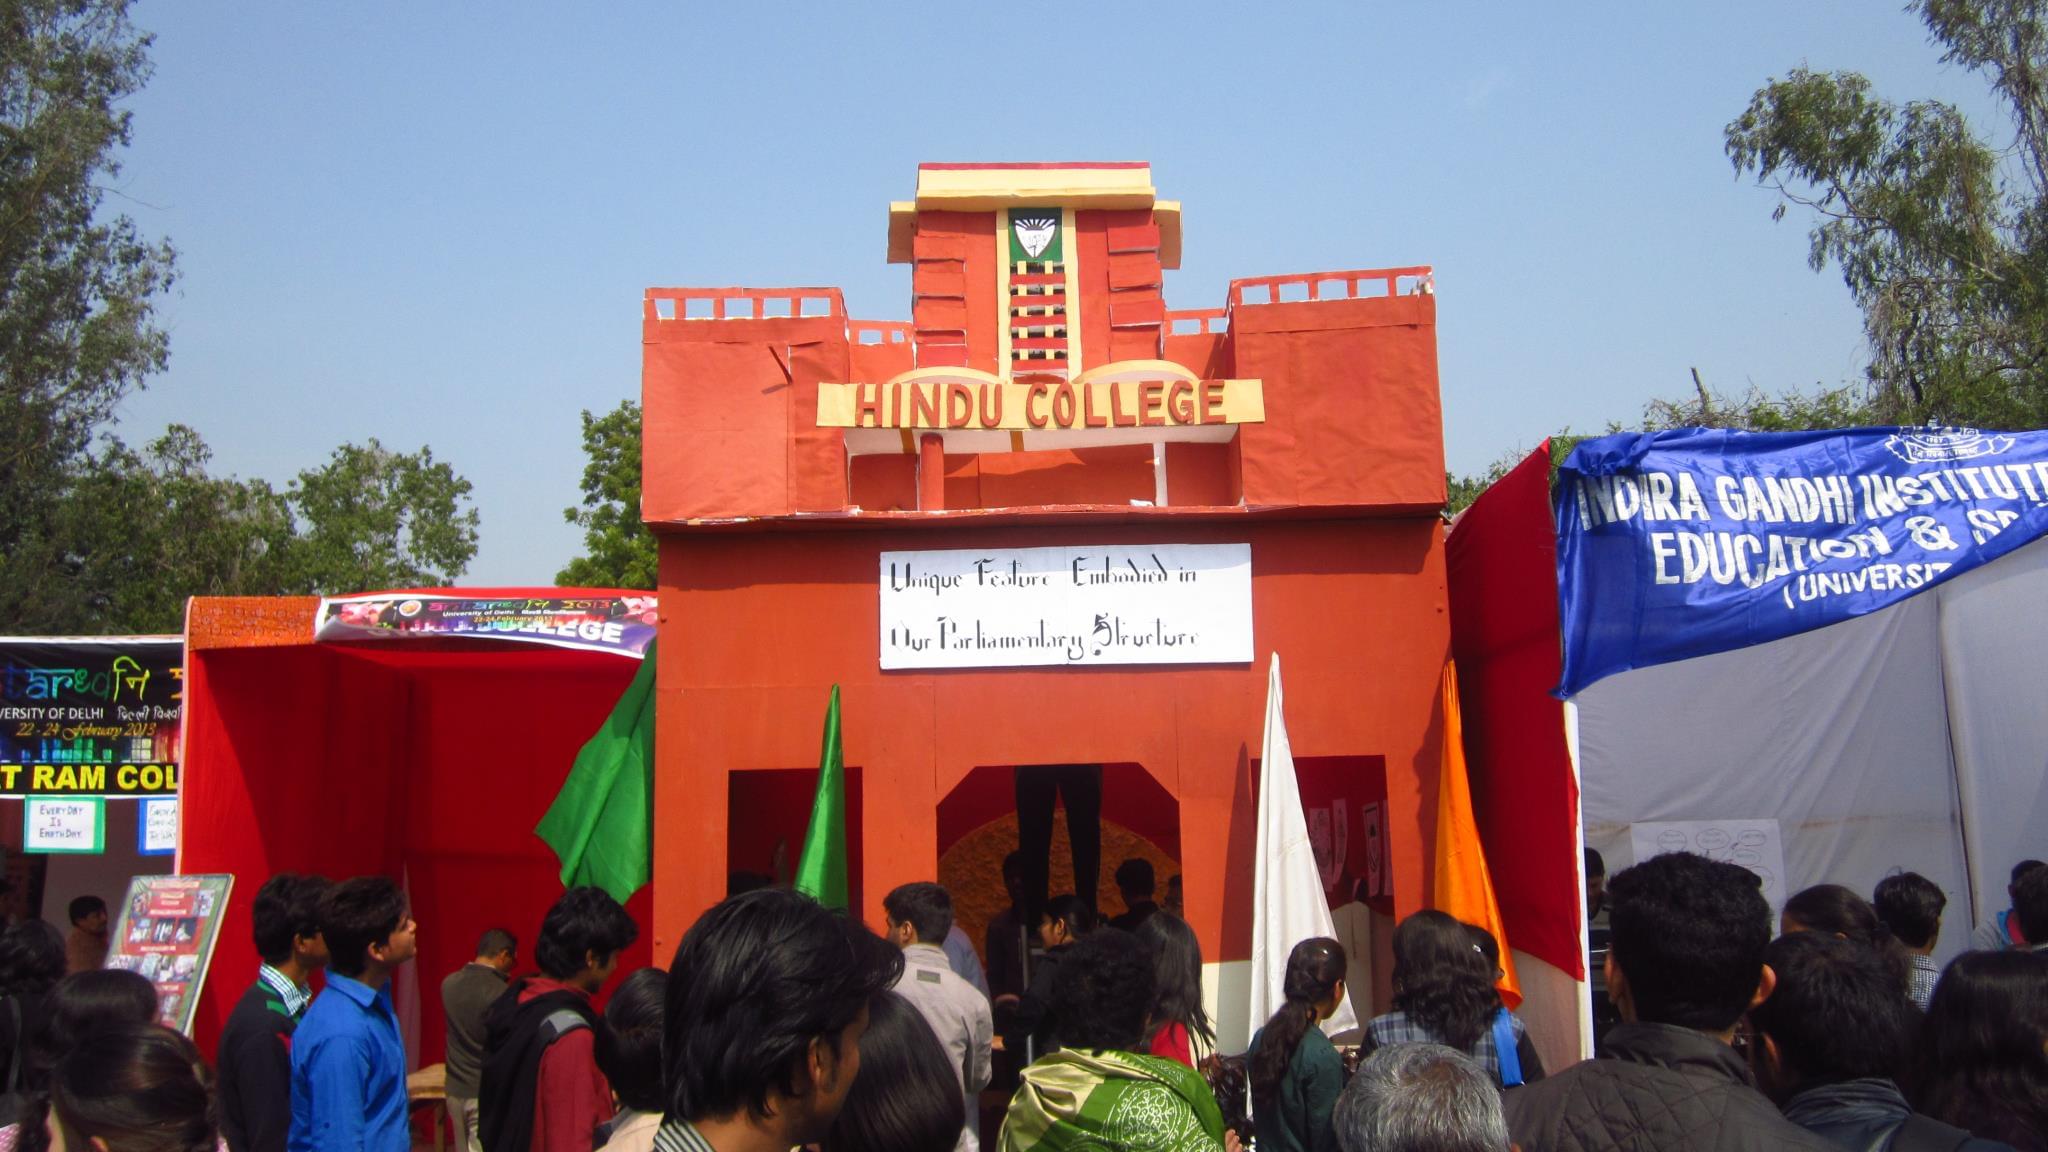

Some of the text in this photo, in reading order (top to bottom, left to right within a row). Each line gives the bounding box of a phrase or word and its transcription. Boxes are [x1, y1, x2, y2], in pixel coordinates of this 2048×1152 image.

[855, 380, 1227, 428] HINDU COLLEGE
[1576, 462, 2048, 531] INDIRA GANDHI INSTITUTE
[891, 553, 1197, 596] Unique Feature Embodied in
[1651, 526, 1893, 589] EDUCATION
[1904, 515, 1960, 552] &
[891, 612, 1200, 661] Our Parliamentary Structure
[16, 722, 33, 736] 22
[42, 722, 60, 736] 24
[62, 721, 123, 740] February
[124, 722, 157, 736] 2013
[49, 707, 66, 719] OF
[69, 707, 103, 719] DELHI
[32, 765, 105, 790] RAM
[117, 765, 178, 790] COL
